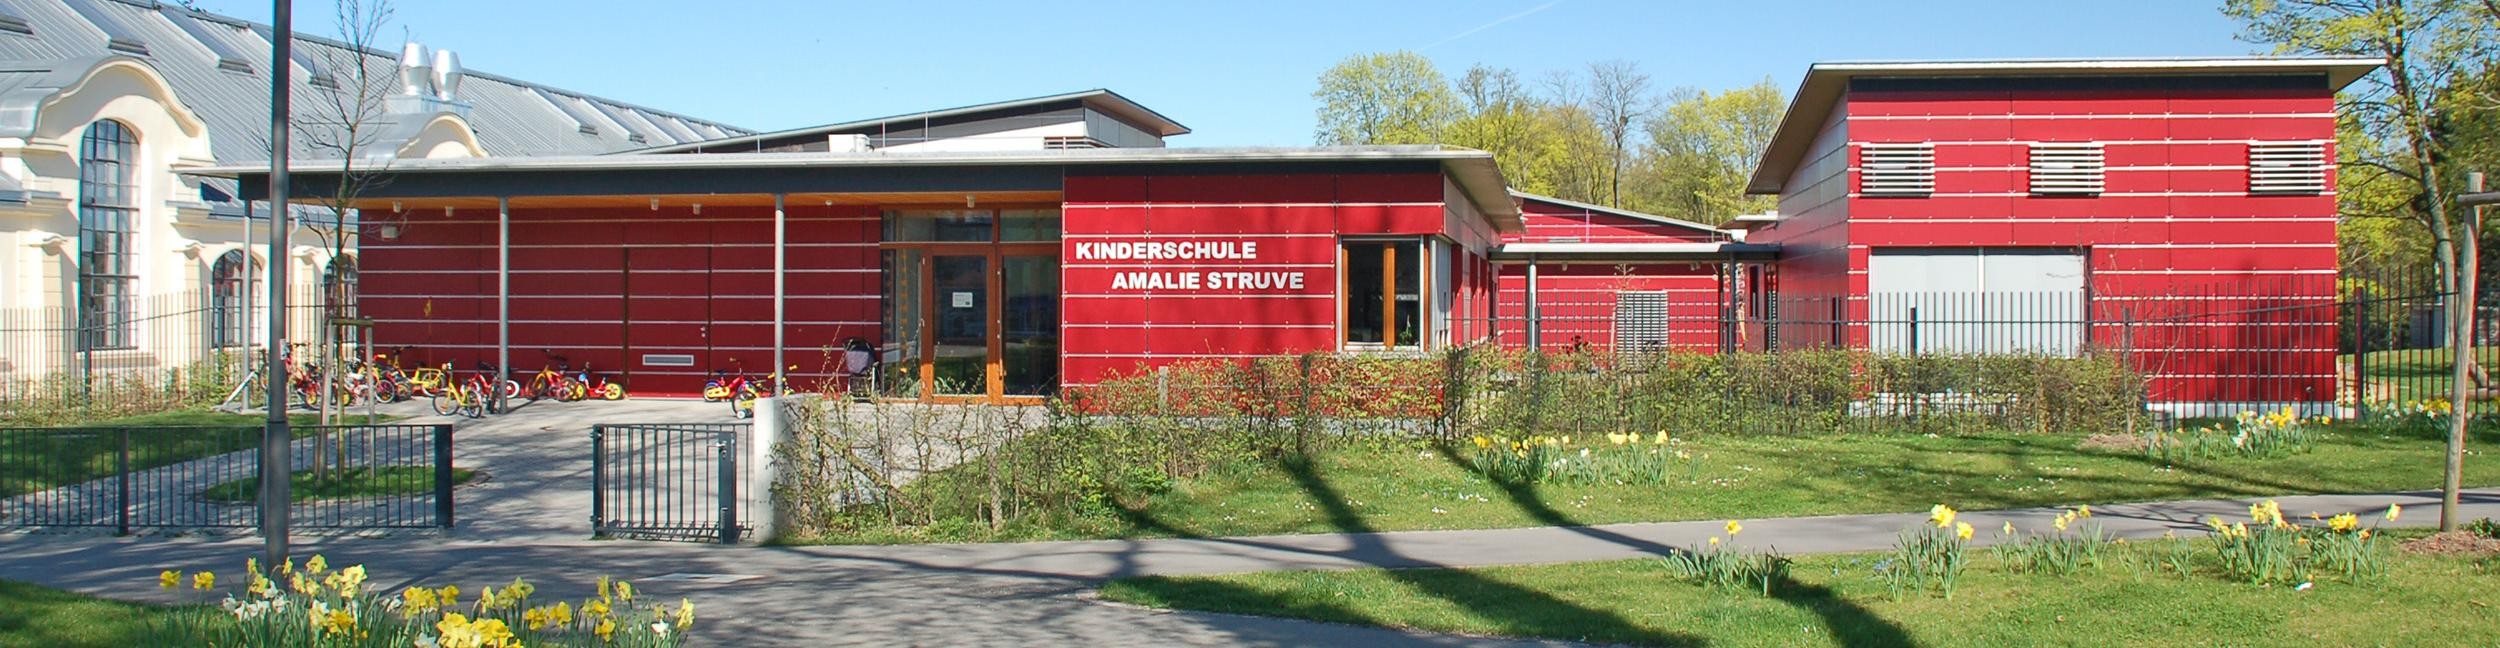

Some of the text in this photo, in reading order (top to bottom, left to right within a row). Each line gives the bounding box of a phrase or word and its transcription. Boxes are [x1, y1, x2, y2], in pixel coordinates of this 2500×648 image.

[1075, 241, 1257, 260] KINDERSCHULE
[1112, 271, 1304, 290] AMALIE STRUVE
